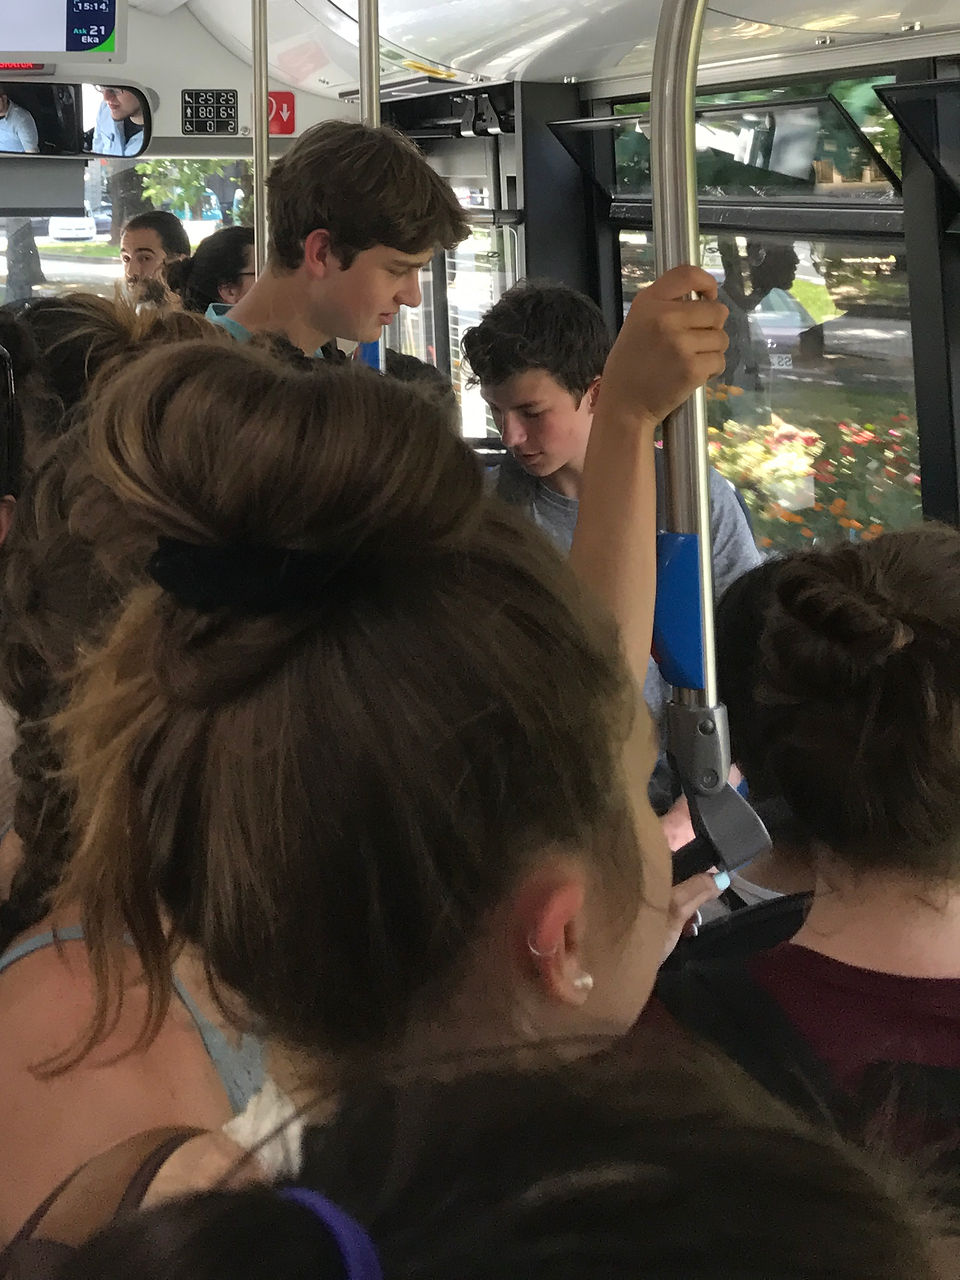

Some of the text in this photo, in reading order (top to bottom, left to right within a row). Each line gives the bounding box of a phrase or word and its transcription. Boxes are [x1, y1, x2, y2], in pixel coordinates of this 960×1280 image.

[77, 2, 106, 10] 15:14
[89, 25, 105, 35] 21
[81, 35, 100, 43] Eka
[198, 92, 235, 104] 25 25
[198, 106, 235, 118] 80 64
[206, 120, 235, 132] 0 2
